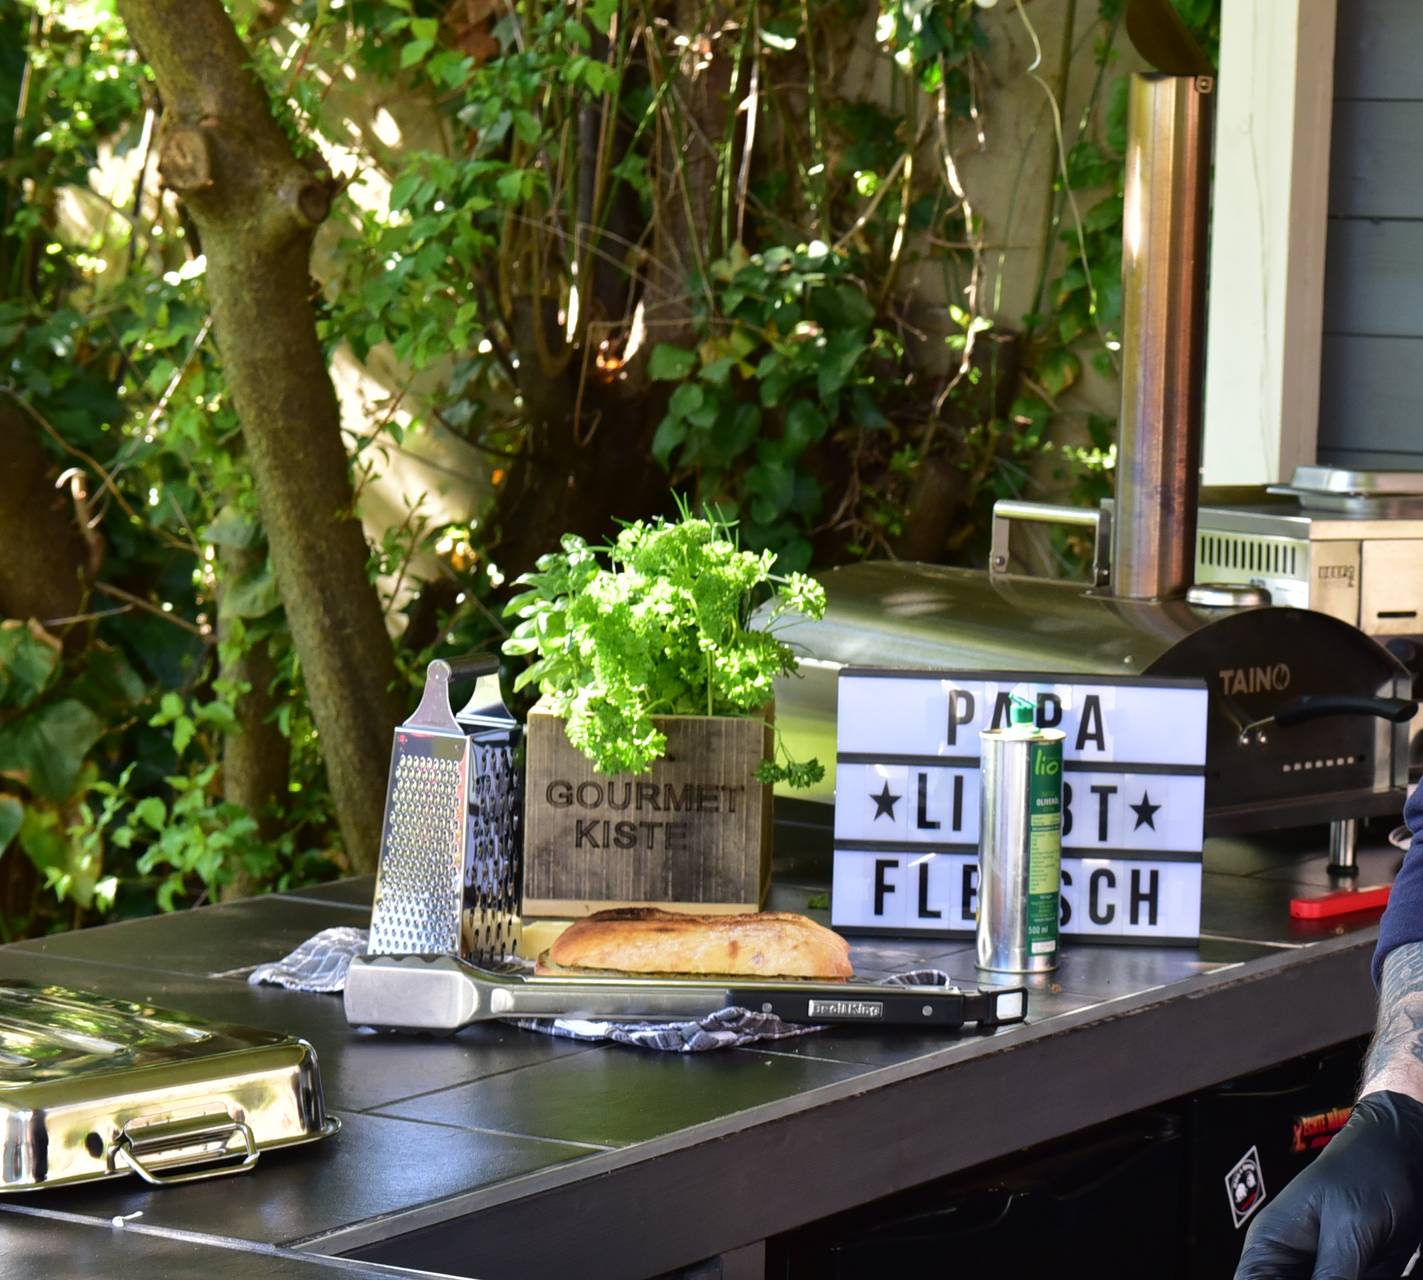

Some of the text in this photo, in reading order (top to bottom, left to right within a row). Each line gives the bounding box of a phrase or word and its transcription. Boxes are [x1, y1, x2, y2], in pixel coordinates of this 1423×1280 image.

[1034, 748, 1059, 776] lio
[545, 780, 745, 813] GOURMET
[575, 819, 687, 850] KISTE
